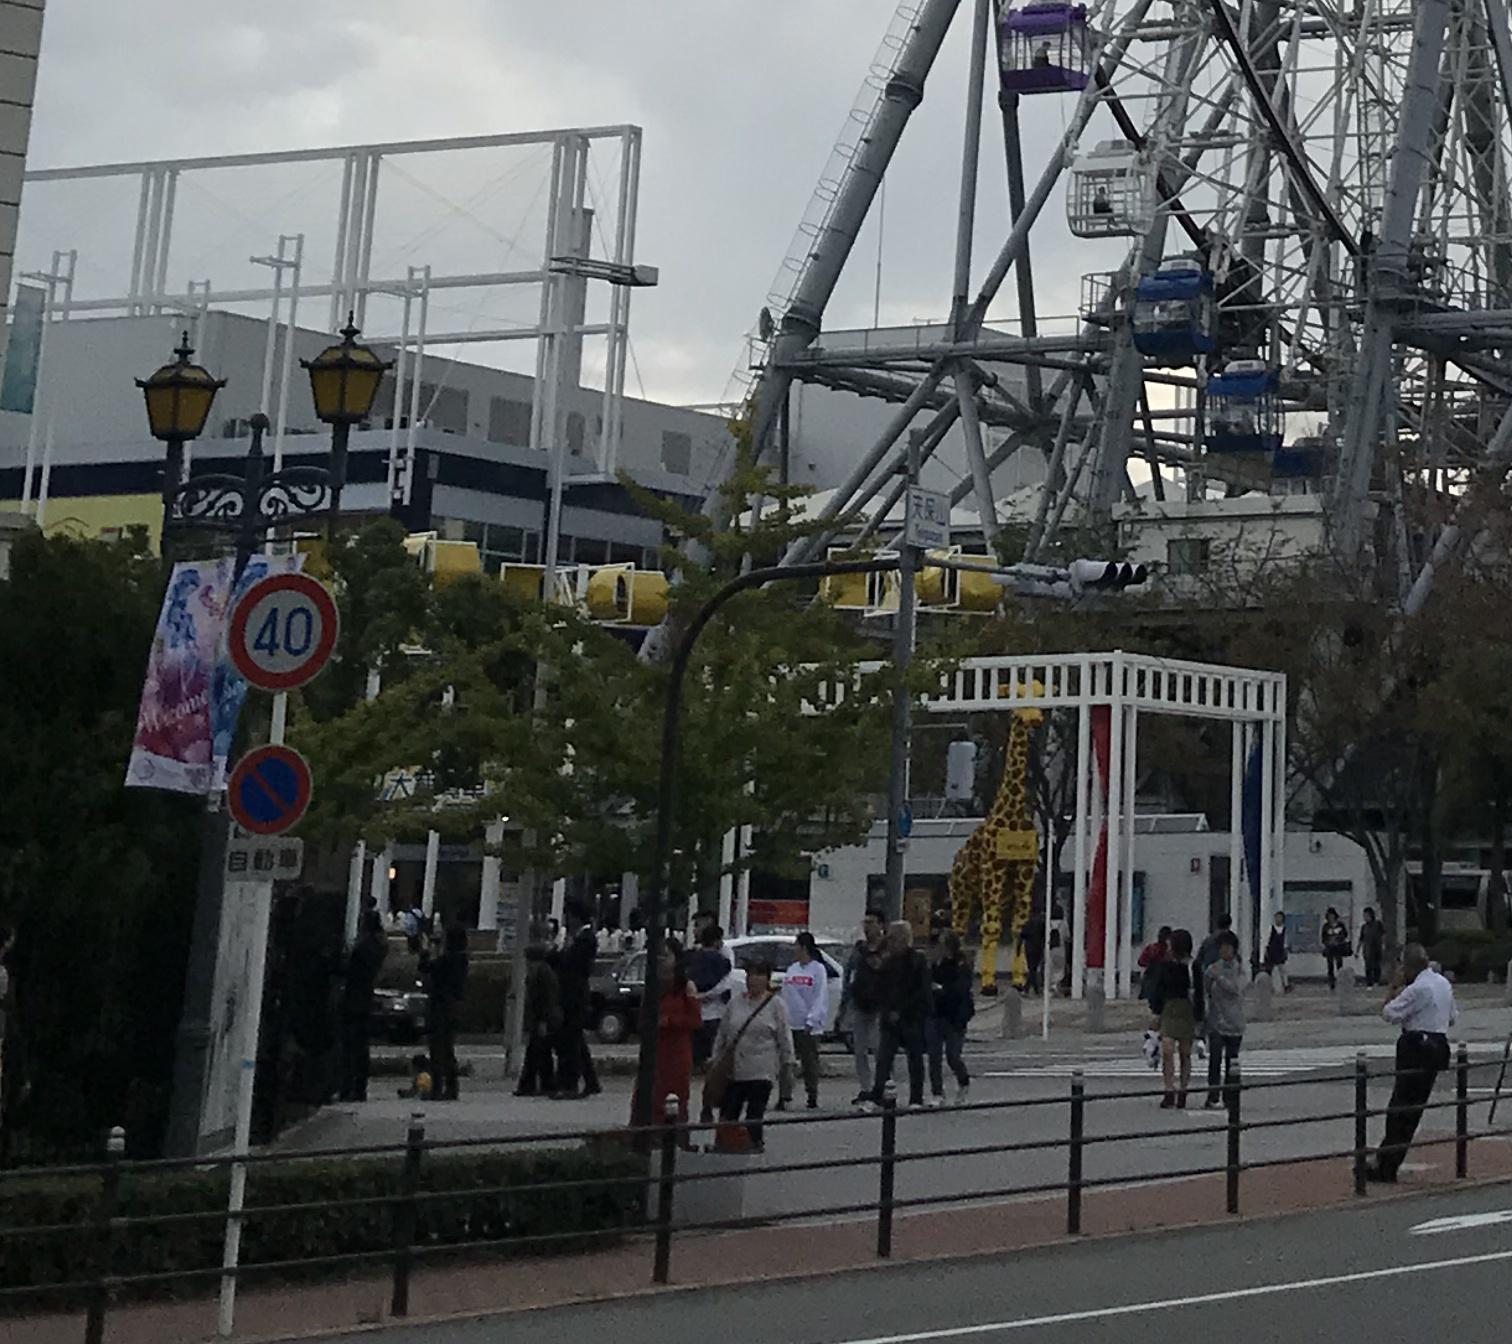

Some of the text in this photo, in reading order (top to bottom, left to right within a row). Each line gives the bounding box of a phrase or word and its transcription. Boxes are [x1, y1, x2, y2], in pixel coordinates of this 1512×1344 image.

[253, 606, 313, 657] 40
[228, 847, 298, 872] 自動車
